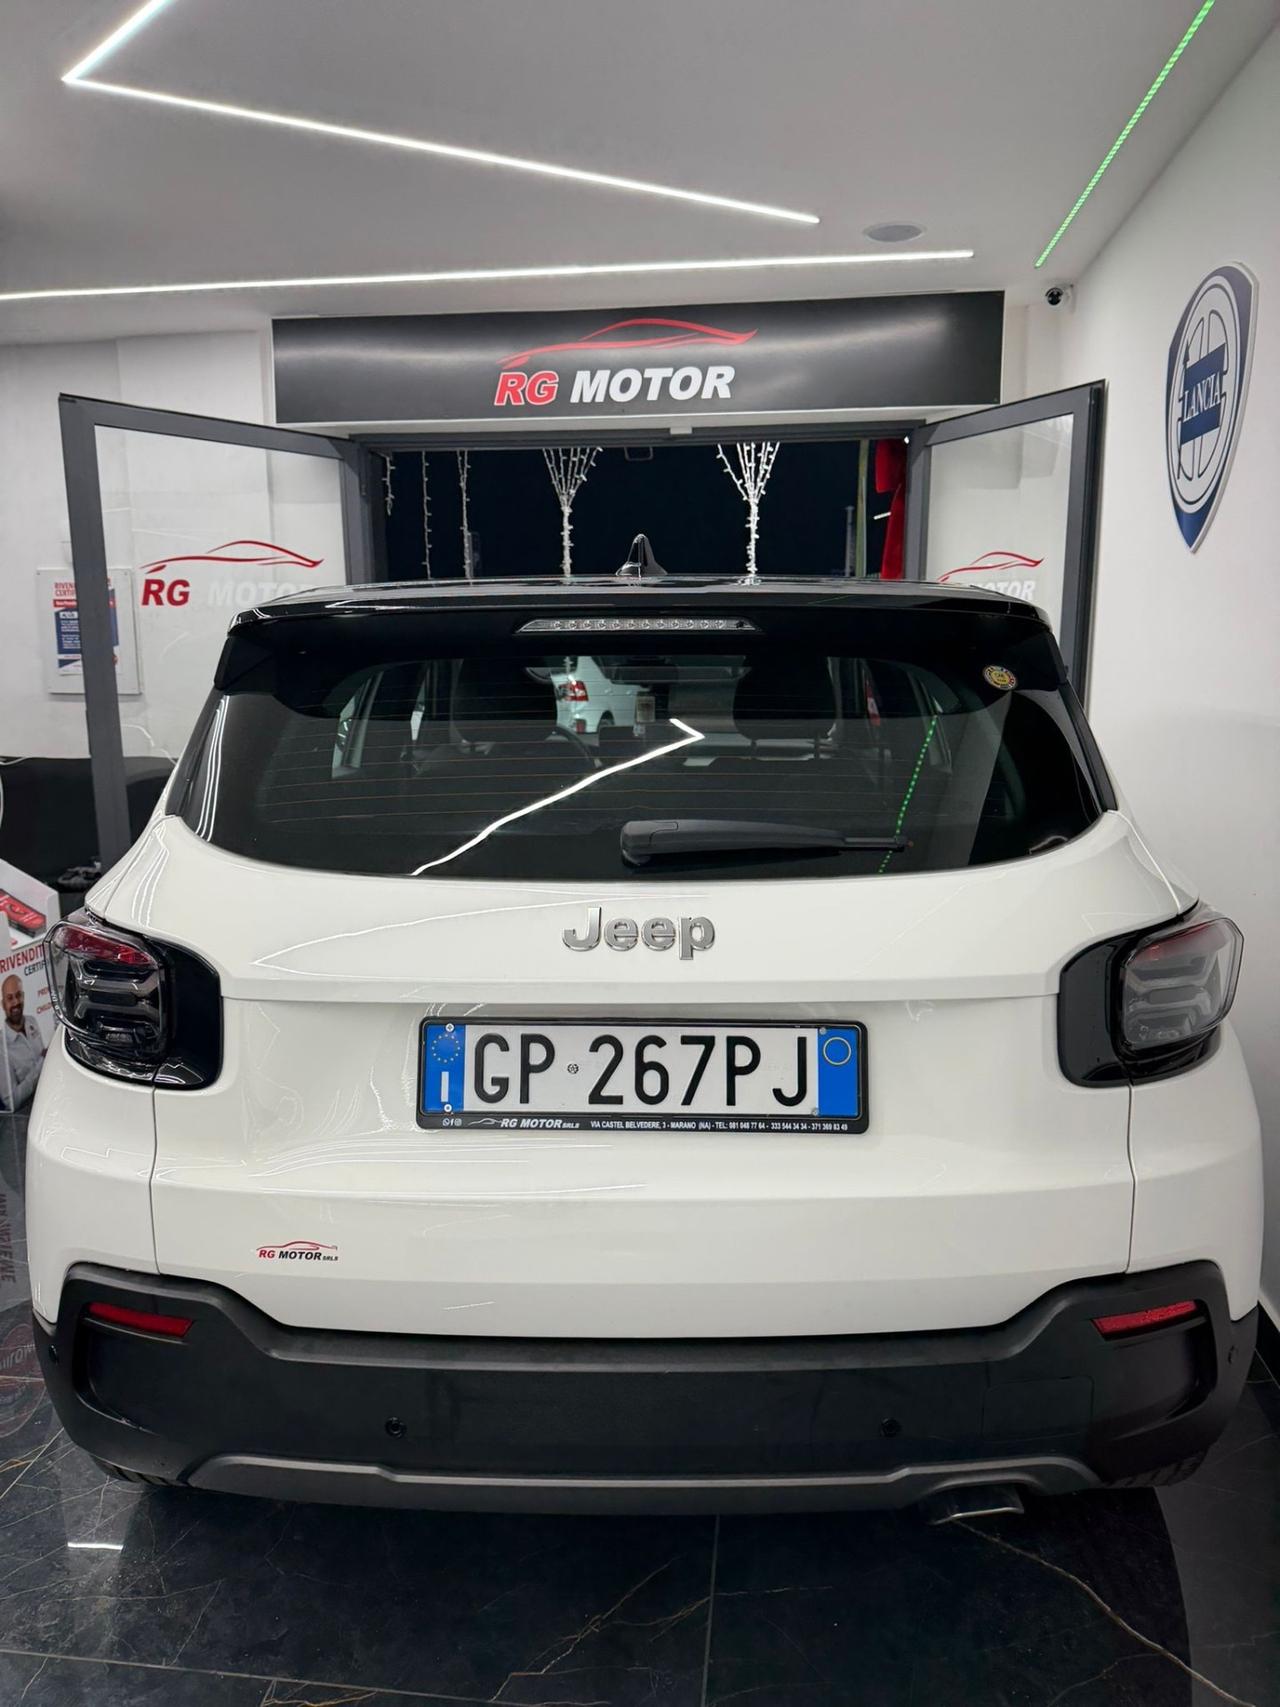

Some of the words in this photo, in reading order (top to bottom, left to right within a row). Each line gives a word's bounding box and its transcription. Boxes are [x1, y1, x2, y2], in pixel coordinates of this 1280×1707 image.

[494, 370, 559, 406] RG
[570, 366, 735, 403] MOTOR
[1183, 371, 1221, 423] LANCIA
[141, 578, 190, 606] RG
[562, 906, 716, 960] Jeep
[0, 944, 45, 974] RIVENDIT
[500, 1118, 518, 1128] RG
[520, 1118, 562, 1129] MOTOR
[601, 1121, 625, 1129] CASTEL
[670, 1121, 697, 1129] MARANO
[258, 1249, 276, 1259] RG
[278, 1250, 322, 1261] MOTOR
